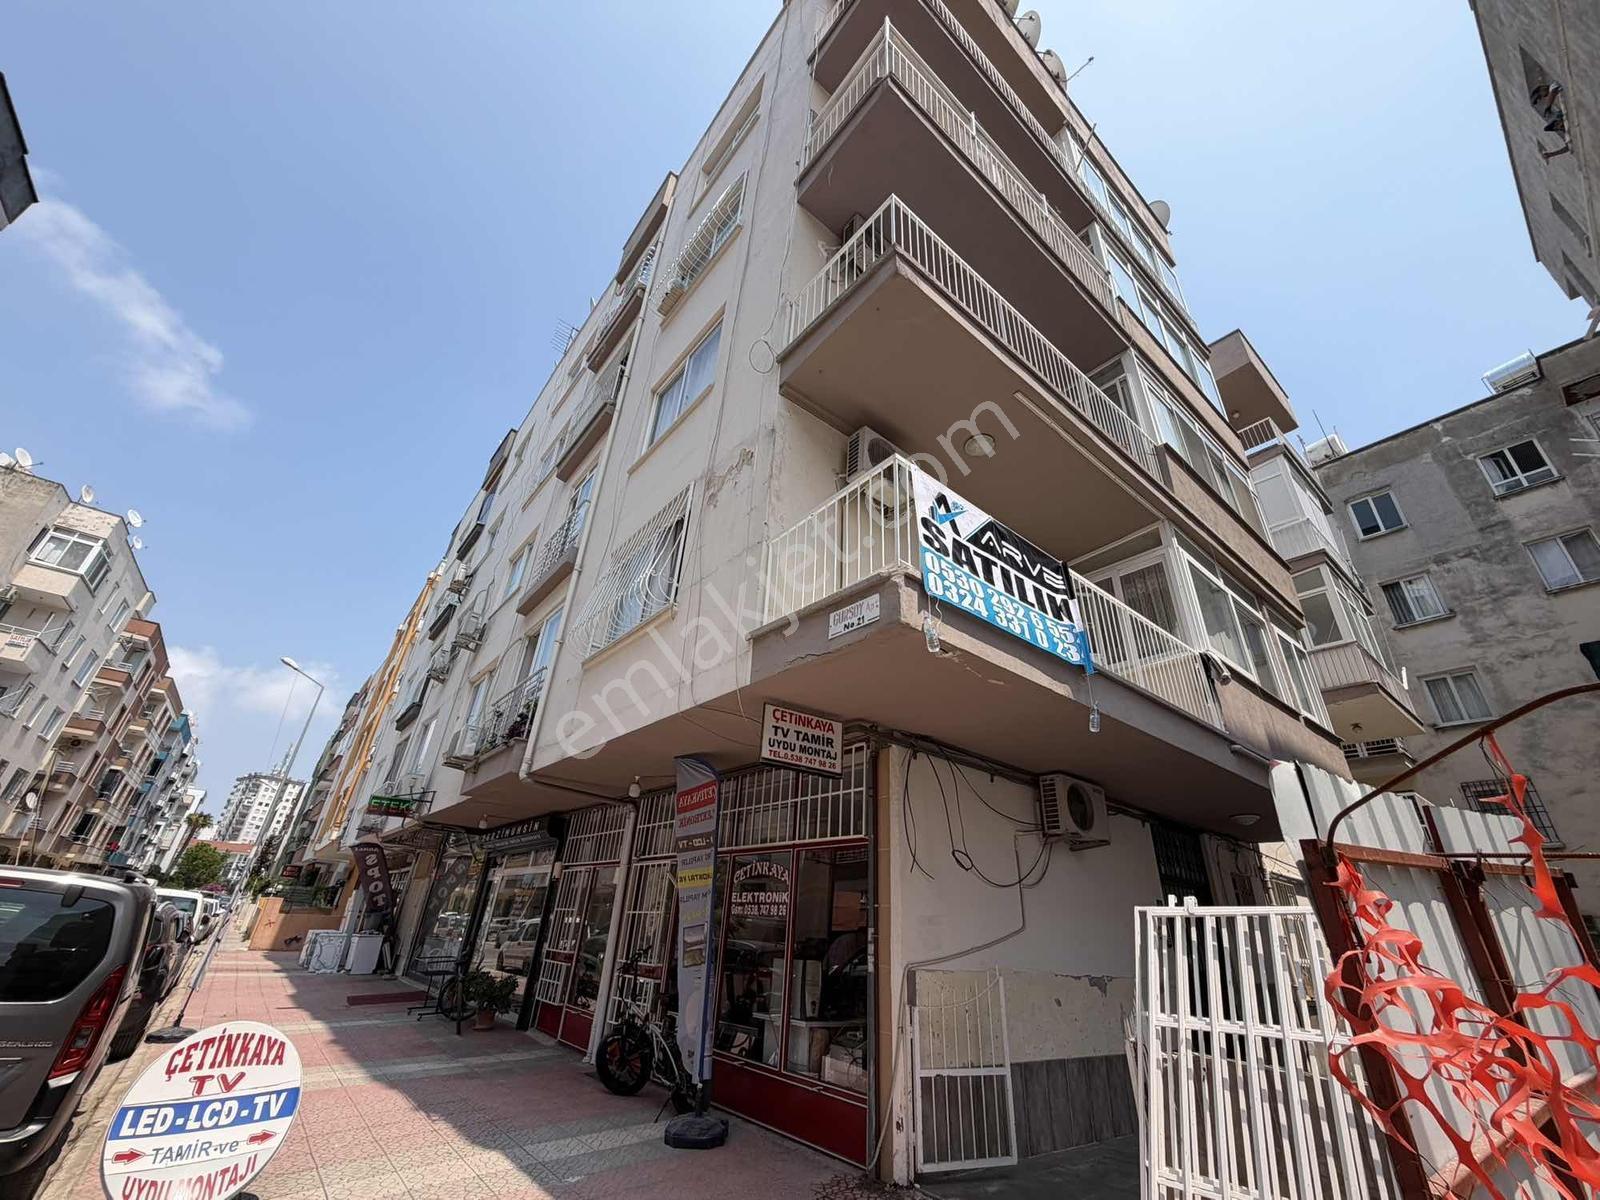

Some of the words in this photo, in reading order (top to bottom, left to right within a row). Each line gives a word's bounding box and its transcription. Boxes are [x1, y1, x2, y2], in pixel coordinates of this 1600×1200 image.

[920, 516, 1076, 625] SATILIK
[981, 531, 1066, 589] ARVE
[924, 552, 985, 599] 0530
[987, 588, 1026, 622] 292
[1031, 612, 1044, 631] 6
[1048, 618, 1080, 644] 55
[928, 572, 988, 618] 0324
[994, 606, 1030, 640] 331
[1037, 627, 1049, 649] 0
[1055, 637, 1084, 663] 23
[772, 708, 835, 735] ÇETİNKAYA
[768, 738, 796, 752] UYDU
[799, 744, 837, 761] MONTAJ
[772, 725, 790, 739] TV
[794, 730, 834, 749] TAMİR
[804, 757, 817, 766] 747
[828, 762, 837, 770] 26
[731, 891, 789, 903] ELEKTRONİK
[165, 1027, 287, 1082] ÇETİNKAYA
[189, 1071, 247, 1098] TV
